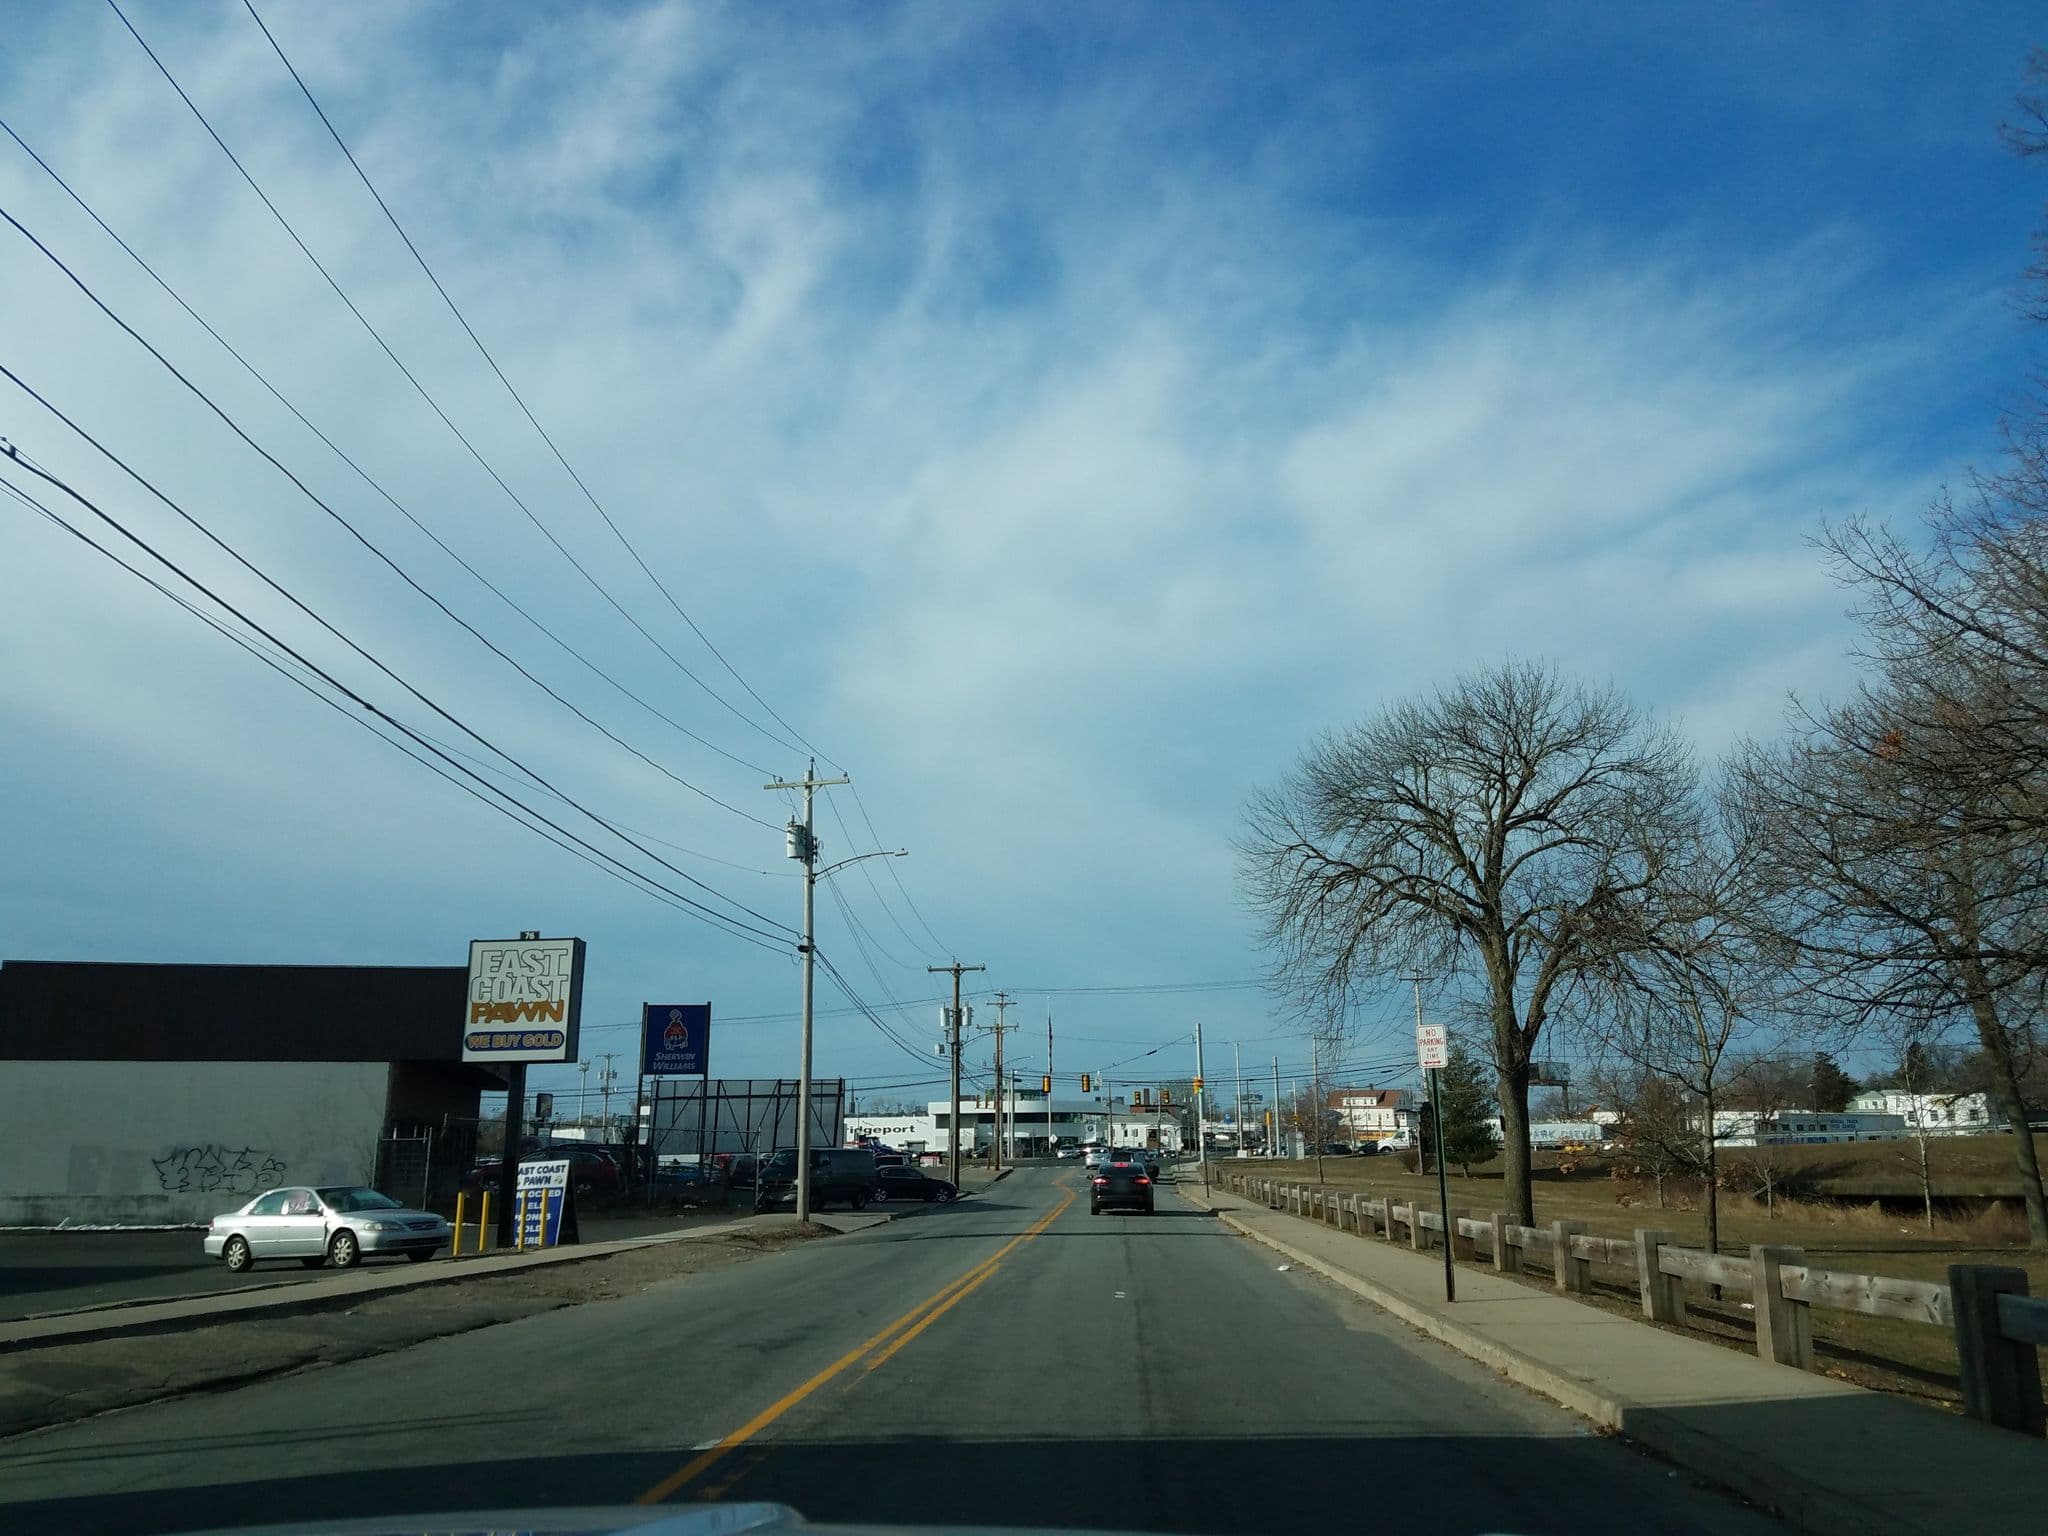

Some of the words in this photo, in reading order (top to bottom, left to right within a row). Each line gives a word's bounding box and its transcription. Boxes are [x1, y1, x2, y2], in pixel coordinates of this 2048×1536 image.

[481, 949, 568, 977] EAST
[471, 975, 568, 1004] COAST
[471, 1000, 565, 1024] PAWN
[1425, 1029, 1436, 1037] NO
[468, 1035, 490, 1049] WE
[492, 1034, 521, 1048] BUY
[523, 1033, 563, 1047] GOLD
[1419, 1038, 1444, 1046] PARKING
[655, 1052, 696, 1060] SHERWIN
[653, 1061, 696, 1070] WILLIAMS
[846, 1125, 915, 1135] idgeport
[518, 1166, 535, 1175] AST
[537, 1165, 566, 1174] COAST
[523, 1176, 552, 1186] PAWN
